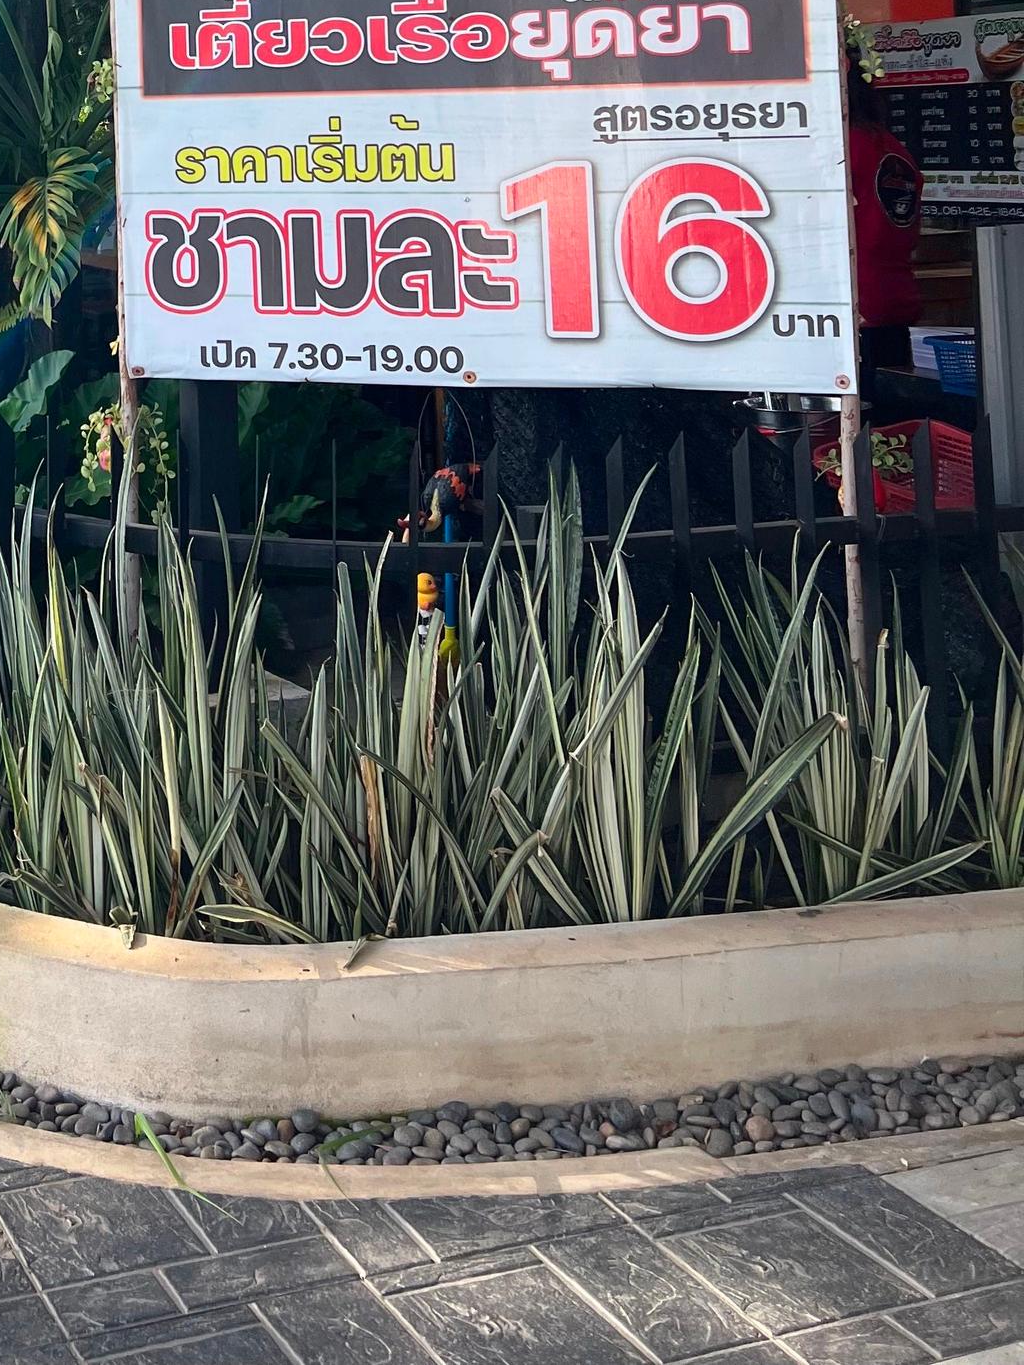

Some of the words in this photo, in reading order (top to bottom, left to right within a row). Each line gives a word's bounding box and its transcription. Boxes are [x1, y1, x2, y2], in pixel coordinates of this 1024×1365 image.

[175, 114, 457, 185] ราคาเริ่มต้น
[593, 101, 809, 144] สูตรอยุธยา
[145, 207, 519, 318] ชามละ
[500, 155, 776, 342] 16
[772, 310, 842, 340] บาท
[198, 339, 257, 371] เปิด
[268, 342, 465, 374] 7.30-19.00
